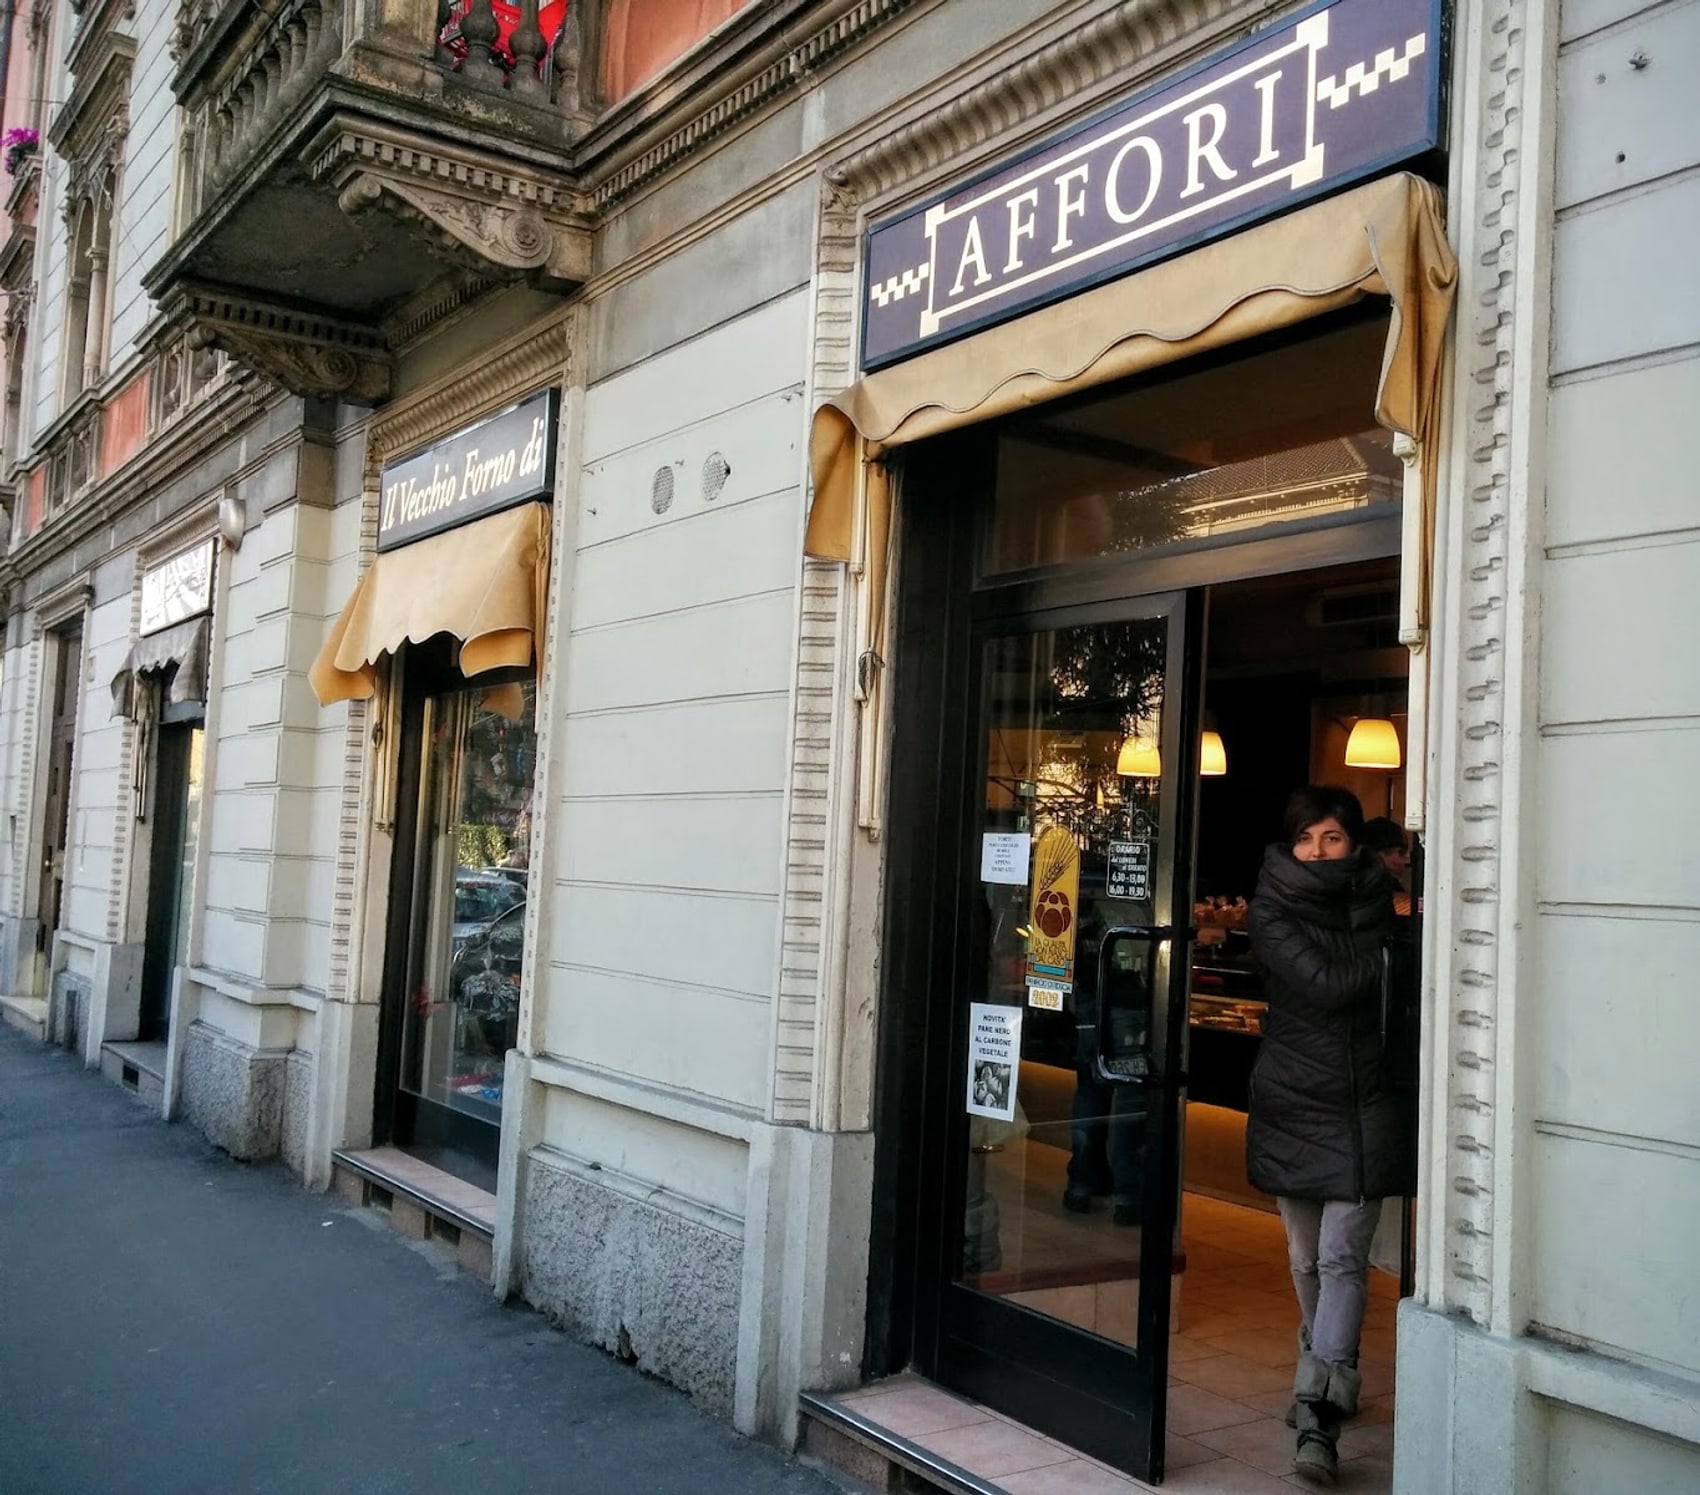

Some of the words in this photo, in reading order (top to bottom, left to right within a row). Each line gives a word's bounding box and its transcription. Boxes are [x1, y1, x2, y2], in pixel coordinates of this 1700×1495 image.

[949, 70, 1283, 297] AFFORI
[380, 482, 398, 532] Il
[399, 463, 456, 525] Vecchio
[459, 449, 516, 501] Forno
[519, 416, 545, 477] di
[1115, 844, 1141, 855] ORARIO
[978, 1024, 993, 1034] PANE
[993, 1027, 1011, 1035] NERO
[975, 1036, 982, 1044] AL
[983, 1036, 1012, 1047] CARBONE
[978, 1047, 1009, 1058] VEGETALE
